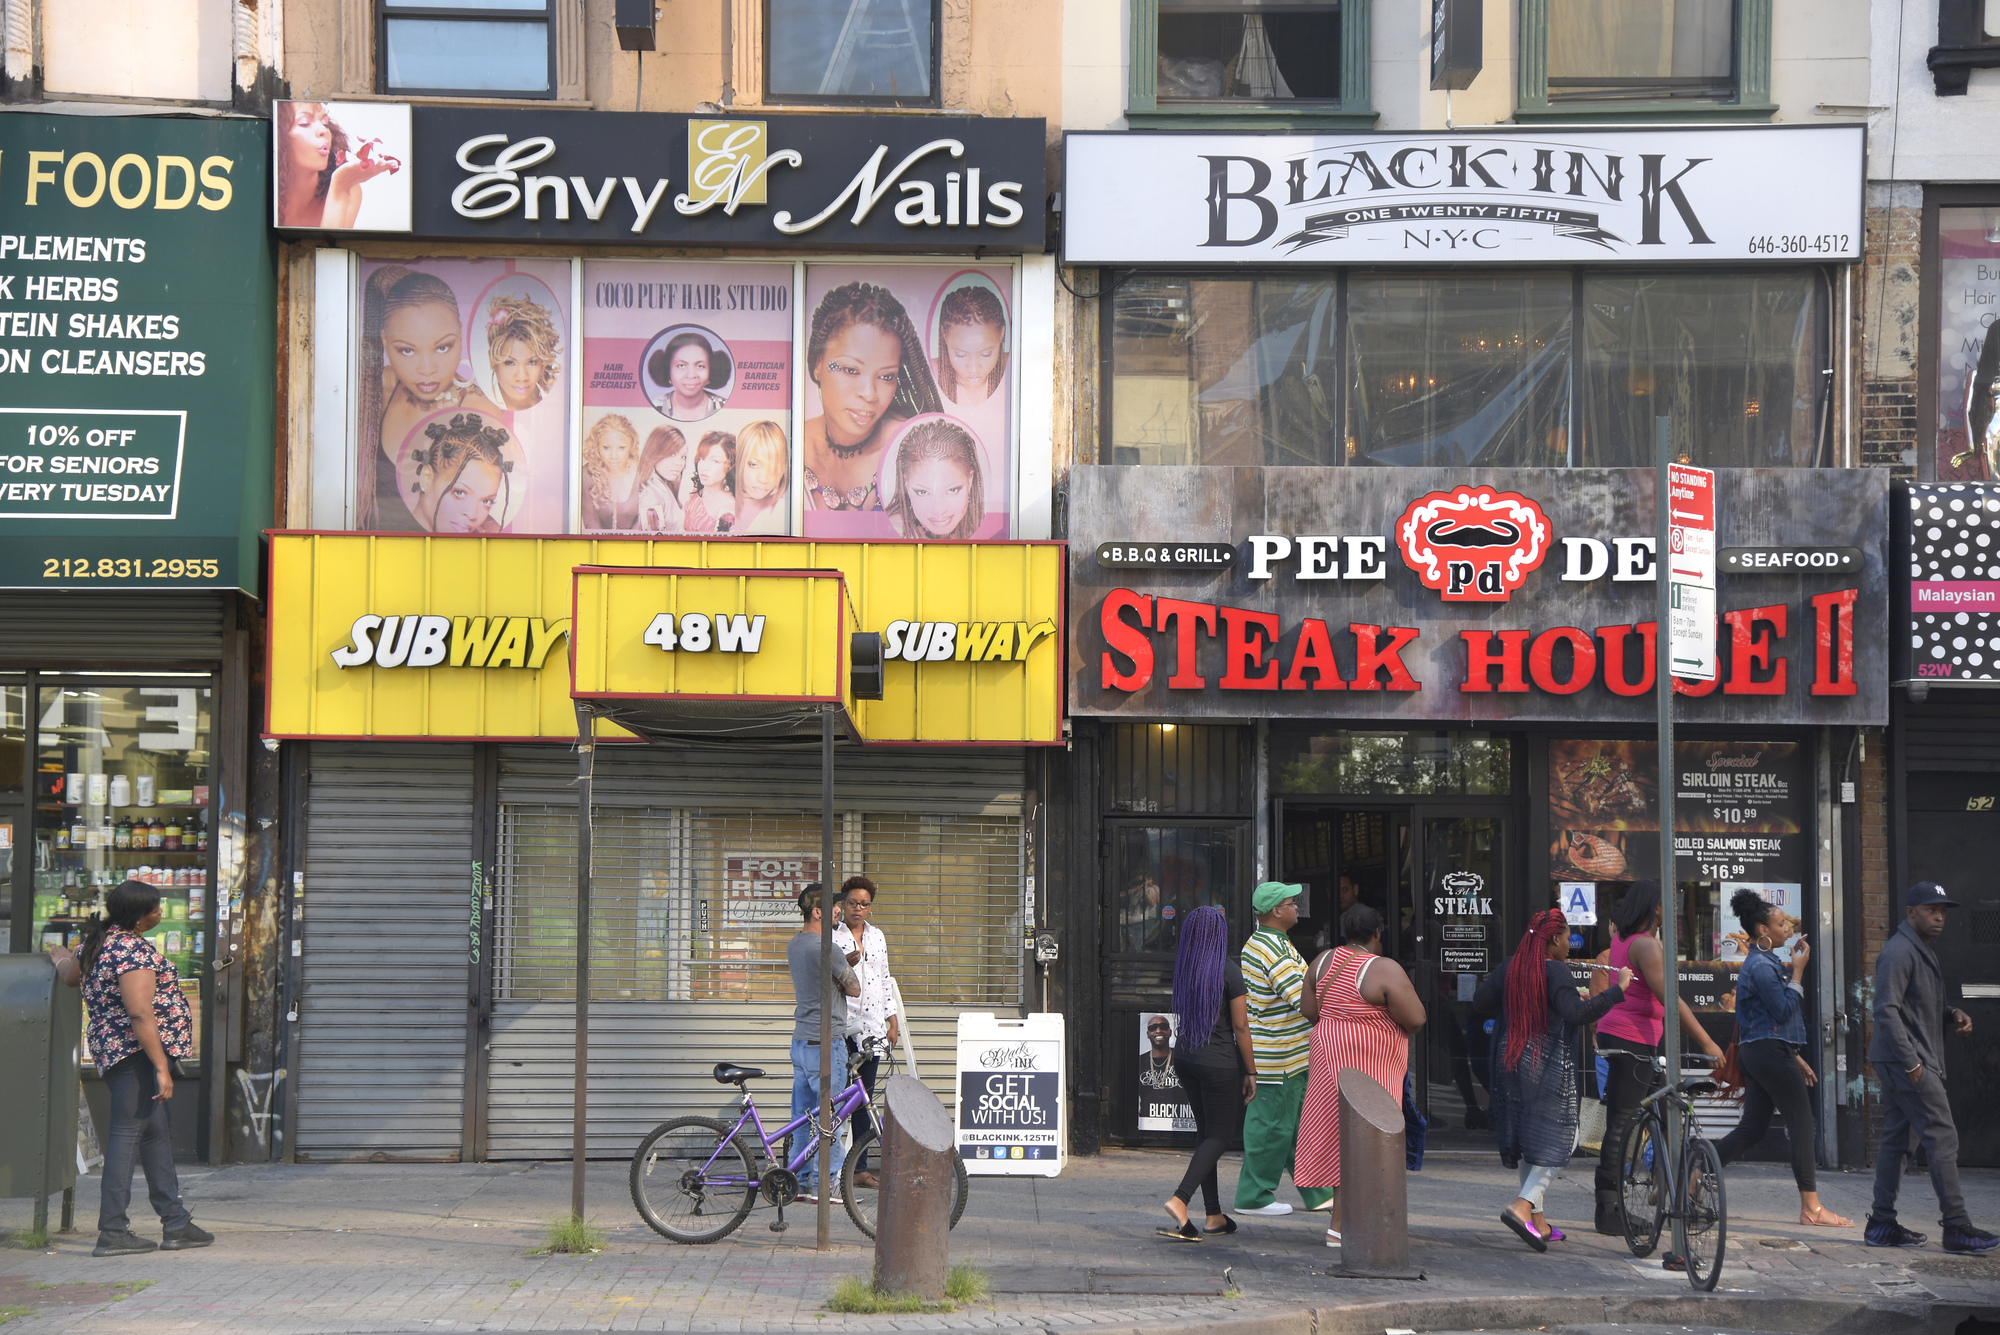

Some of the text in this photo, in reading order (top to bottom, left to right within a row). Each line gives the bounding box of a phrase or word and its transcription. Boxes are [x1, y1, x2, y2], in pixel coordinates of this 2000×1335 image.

[24, 149, 235, 211] FOODS
[451, 133, 669, 233] Envy
[773, 138, 1024, 234] Nails
[1197, 145, 1716, 247] BLACK INK
[1344, 204, 1561, 223] ONE TWENTY FIFTH
[1748, 234, 1849, 254] 646-360-4512
[25, 276, 119, 302] HERBS
[595, 282, 788, 311] COCO PUFF HAIR STUDIO
[1964, 289, 1997, 304] Hair
[68, 313, 180, 340] SHAKES
[41, 349, 206, 377] CLEANSERS
[603, 363, 623, 371] HAIR
[737, 362, 785, 370] BEAUTICIAN
[589, 380, 637, 389] SPECIALIST
[593, 372, 633, 380] BRAIDING
[744, 372, 777, 380] BARBER
[741, 383, 781, 391] SERVICES
[28, 425, 137, 446] 10% OFF
[49, 456, 160, 474] SENIORS
[1671, 471, 1707, 488] NO STANDING
[60, 483, 171, 502] TUESDAY
[1672, 486, 1694, 500] Anytime
[1112, 548, 1223, 563] B.B.Q & GRILL
[1248, 535, 1386, 580] PEE
[1741, 552, 1839, 567] SEAFOOD
[43, 558, 219, 578] 212.831.2955
[1918, 589, 1996, 604] Malaysian
[331, 613, 570, 669] SUBWAY
[643, 612, 766, 654] 48W
[884, 616, 1057, 662] SUBWAY
[1673, 627, 1703, 642] Except Sunday
[1101, 588, 1422, 692] STEAK
[1460, 603, 1788, 697] HOUE
[1918, 663, 1953, 677] 52W
[1706, 751, 1761, 771] Special
[1682, 772, 1731, 787] SIRLOIN
[1734, 773, 1777, 788] STEAK
[1707, 838, 1746, 850] SALMON
[1749, 839, 1781, 850] STEAK
[742, 861, 803, 877] FOR
[1434, 897, 1493, 915] STEAK
[1567, 888, 1589, 912] A
[1762, 889, 1791, 906] MENU
[1688, 973, 1714, 982] FINGERS
[985, 1074, 1035, 1096] GET
[978, 1095, 1040, 1110] SOCIAL
[1150, 1103, 1178, 1118] BLACK
[972, 1110, 1046, 1125] WITH US!
[962, 1133, 1055, 1142] @BLACKINK.125TH
